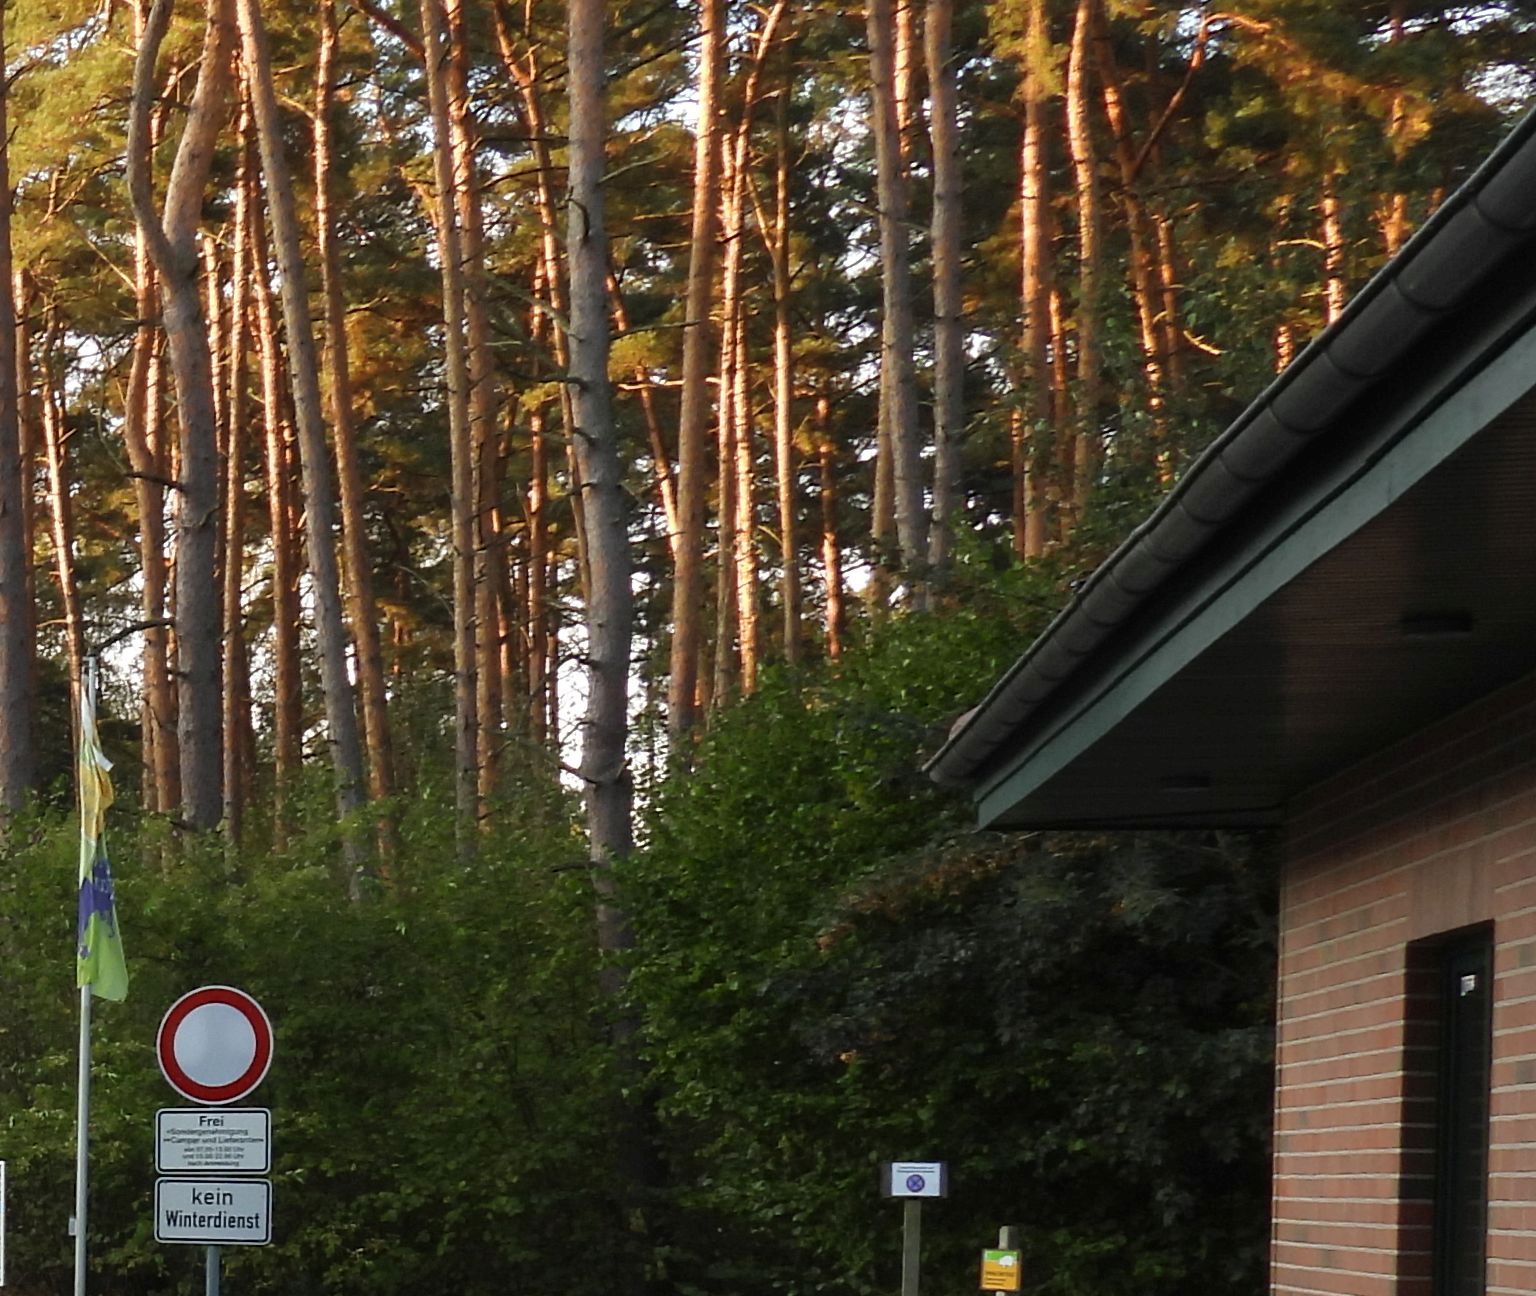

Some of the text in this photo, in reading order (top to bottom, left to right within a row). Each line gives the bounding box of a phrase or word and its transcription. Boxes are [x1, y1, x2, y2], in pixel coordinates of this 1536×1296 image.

[199, 1115, 224, 1127] Frei
[192, 1187, 233, 1205] kein
[166, 1210, 259, 1229] Winterdienst
